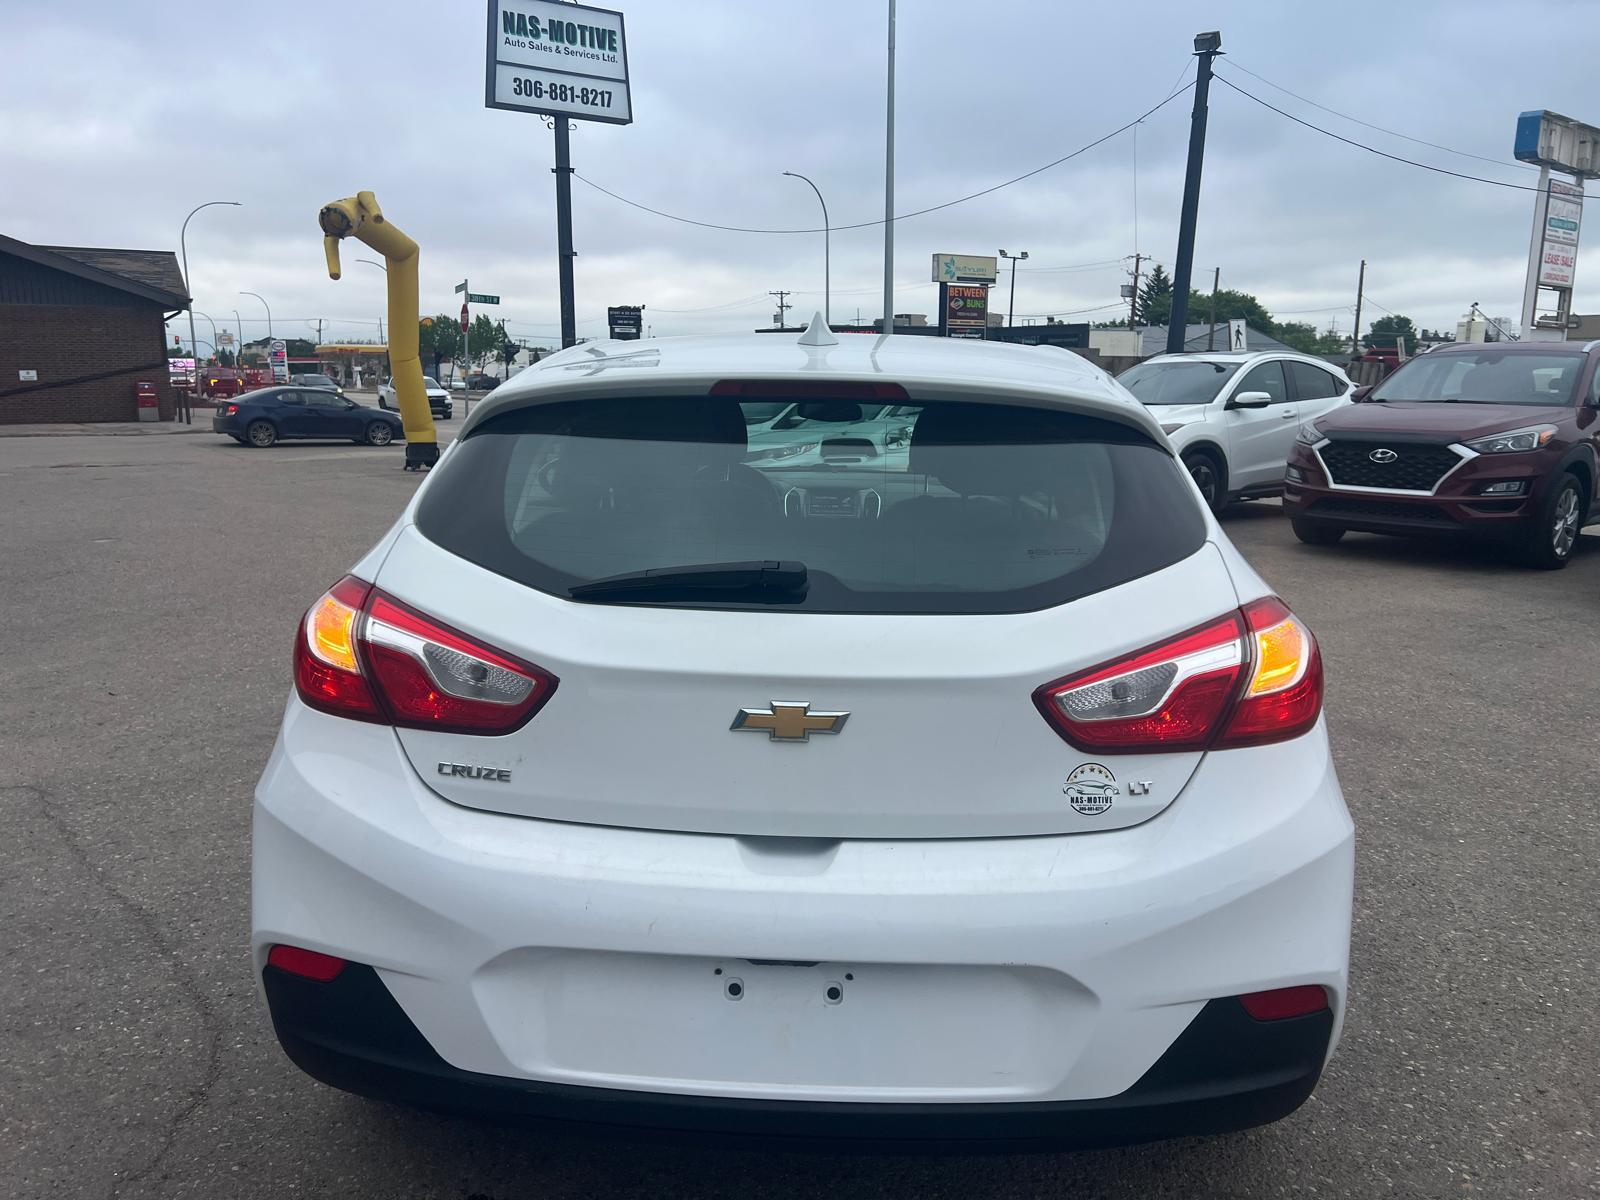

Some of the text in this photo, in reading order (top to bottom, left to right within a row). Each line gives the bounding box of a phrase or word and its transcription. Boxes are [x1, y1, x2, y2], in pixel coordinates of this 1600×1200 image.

[502, 10, 618, 53] NAS-MOTIVE
[504, 36, 618, 63] Auto Sales & Services Ltd.
[512, 77, 613, 108] 306-881-8217
[949, 287, 986, 298] BETWEEN
[966, 299, 985, 309] BUNS
[437, 761, 512, 783] CRUZE
[1128, 780, 1152, 796] LT
[1070, 796, 1113, 804] NAS-MOTIVE
